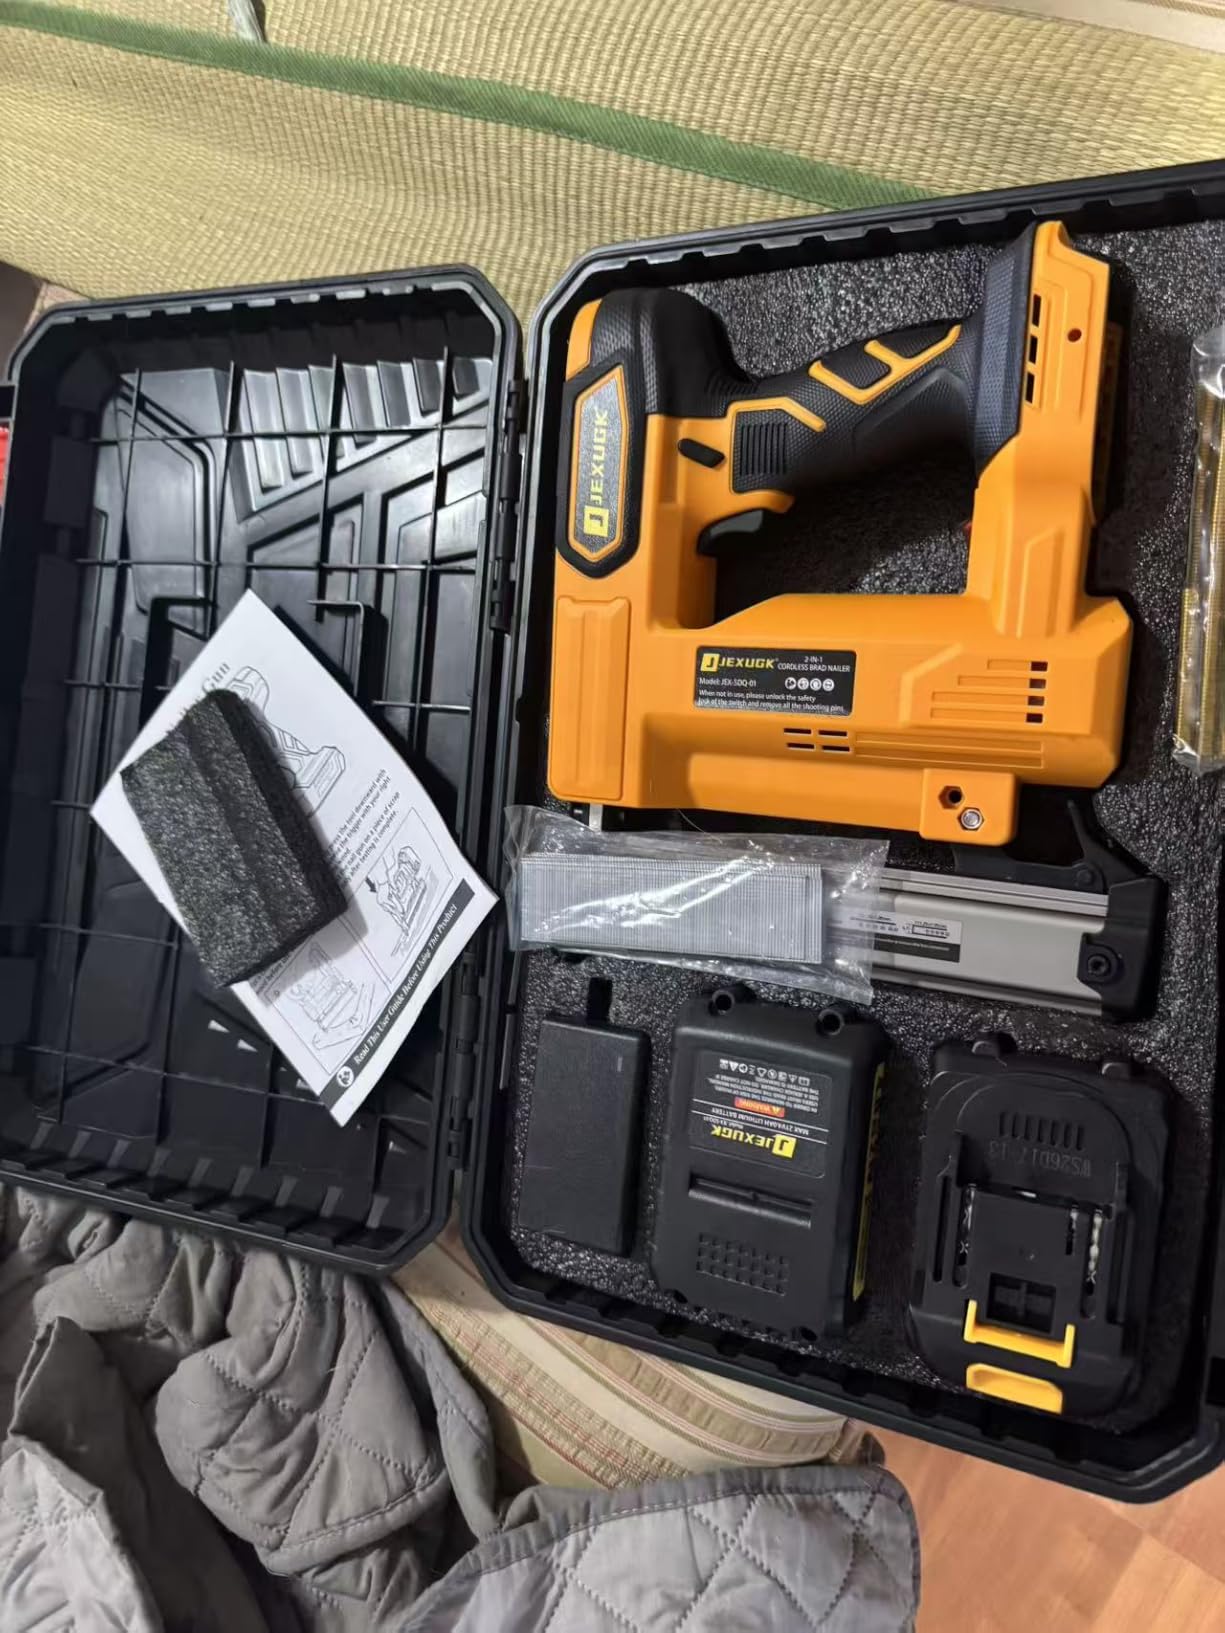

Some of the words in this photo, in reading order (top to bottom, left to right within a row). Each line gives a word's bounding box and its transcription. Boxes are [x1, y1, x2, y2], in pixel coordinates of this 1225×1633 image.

[590, 405, 609, 506] JEXUGK
[719, 657, 775, 669] JEXUGK
[777, 662, 809, 671] CORDLESS
[809, 664, 827, 672] BRAD
[828, 665, 850, 673] NAILER
[699, 689, 715, 698] When
[746, 691, 765, 700] please
[765, 692, 785, 700] unlock
[786, 693, 797, 701] the
[797, 694, 816, 703] safety
[747, 700, 759, 708] and
[760, 701, 783, 709] remove
[791, 702, 802, 710] the
[802, 703, 830, 712] shooting
[376, 768, 386, 783] with
[347, 818, 362, 838] trigger
[360, 804, 371, 819] with
[370, 790, 380, 808] your
[372, 814, 384, 832] piece
[388, 791, 400, 809] scrap
[360, 842, 377, 864] testing
[353, 1043, 370, 1064] Read
[367, 1031, 380, 1047] This
[377, 1014, 390, 1032] User
[387, 993, 405, 1016] Guide
[401, 970, 419, 995] Before
[416, 949, 431, 971] Using
[428, 934, 440, 949] This
[437, 903, 457, 934] Product
[712, 1107, 738, 1119] BATTERY
[738, 1113, 764, 1125] LITHIUM
[711, 1124, 774, 1149] JEXUGK
[794, 1126, 809, 1136] MAX
